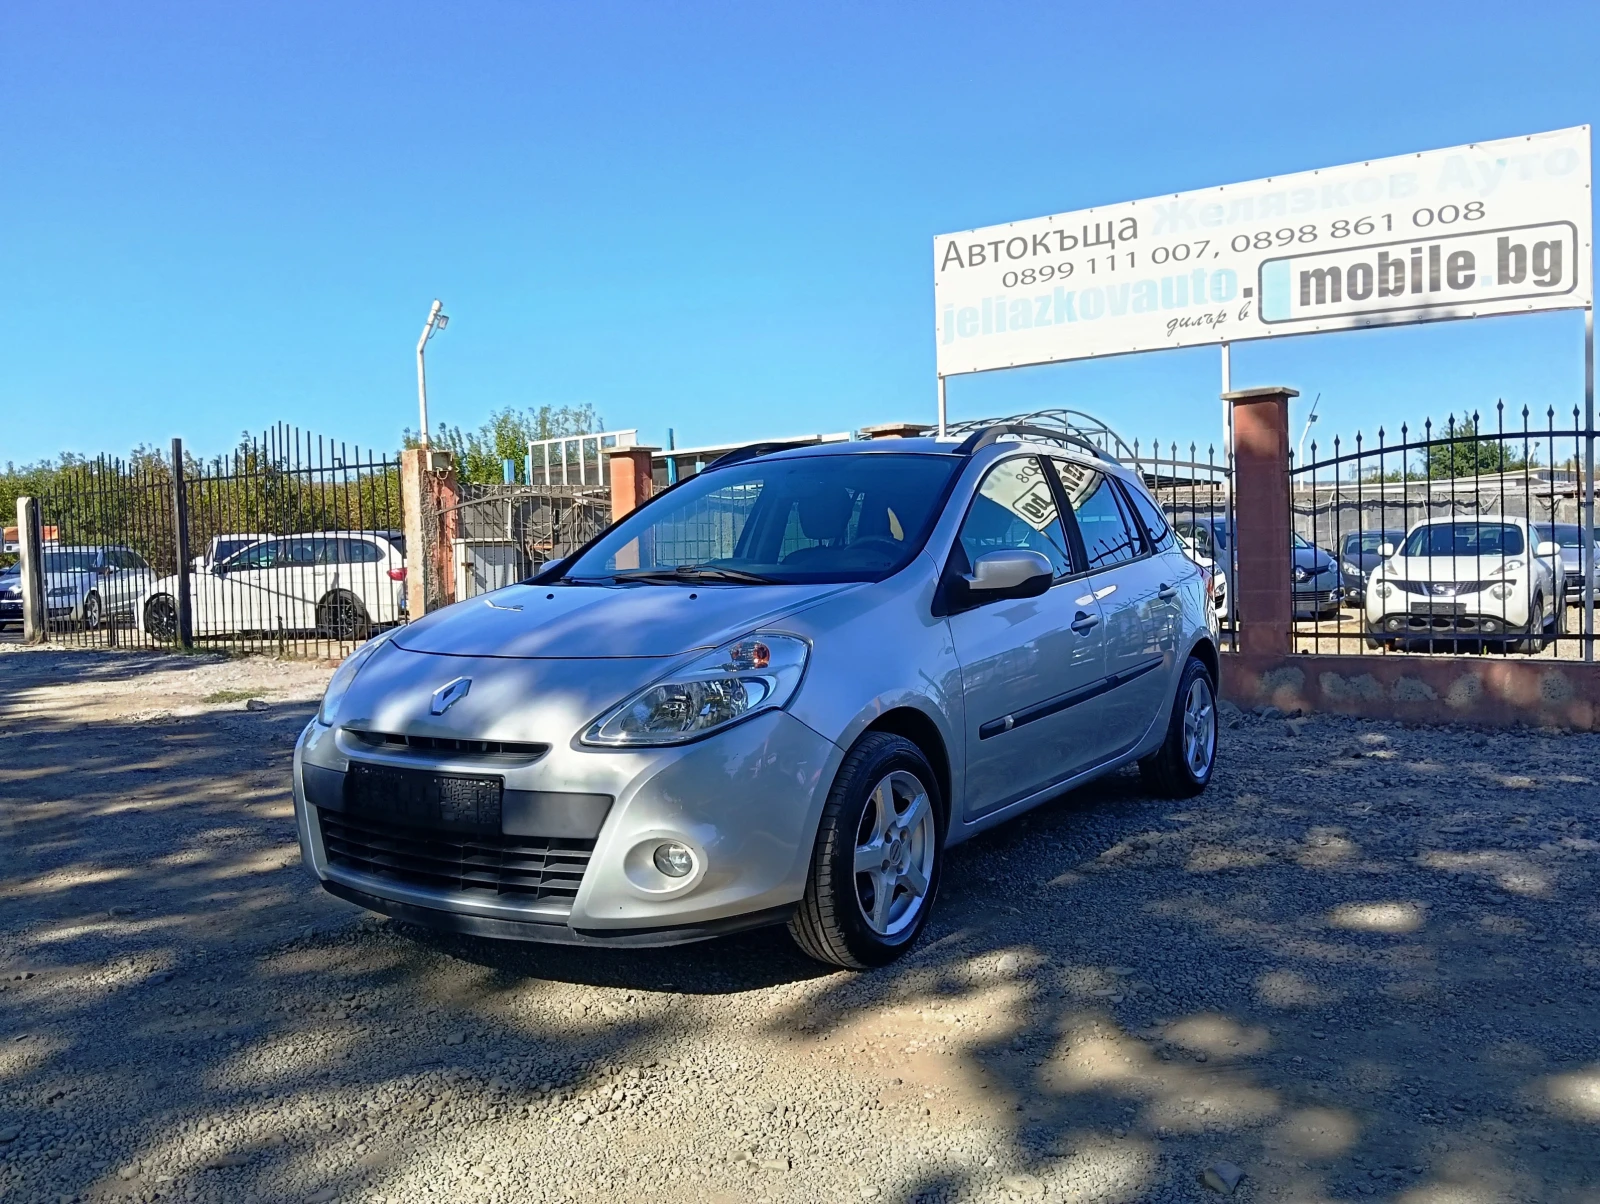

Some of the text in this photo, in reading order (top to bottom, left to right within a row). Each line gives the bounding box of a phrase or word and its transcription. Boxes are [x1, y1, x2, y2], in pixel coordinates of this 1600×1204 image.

[940, 148, 1580, 272] Автокъща Желязков Ауто
[1002, 201, 1487, 288] 0899 111 007, 0898 861 008
[1299, 236, 1563, 307] mobile.bg
